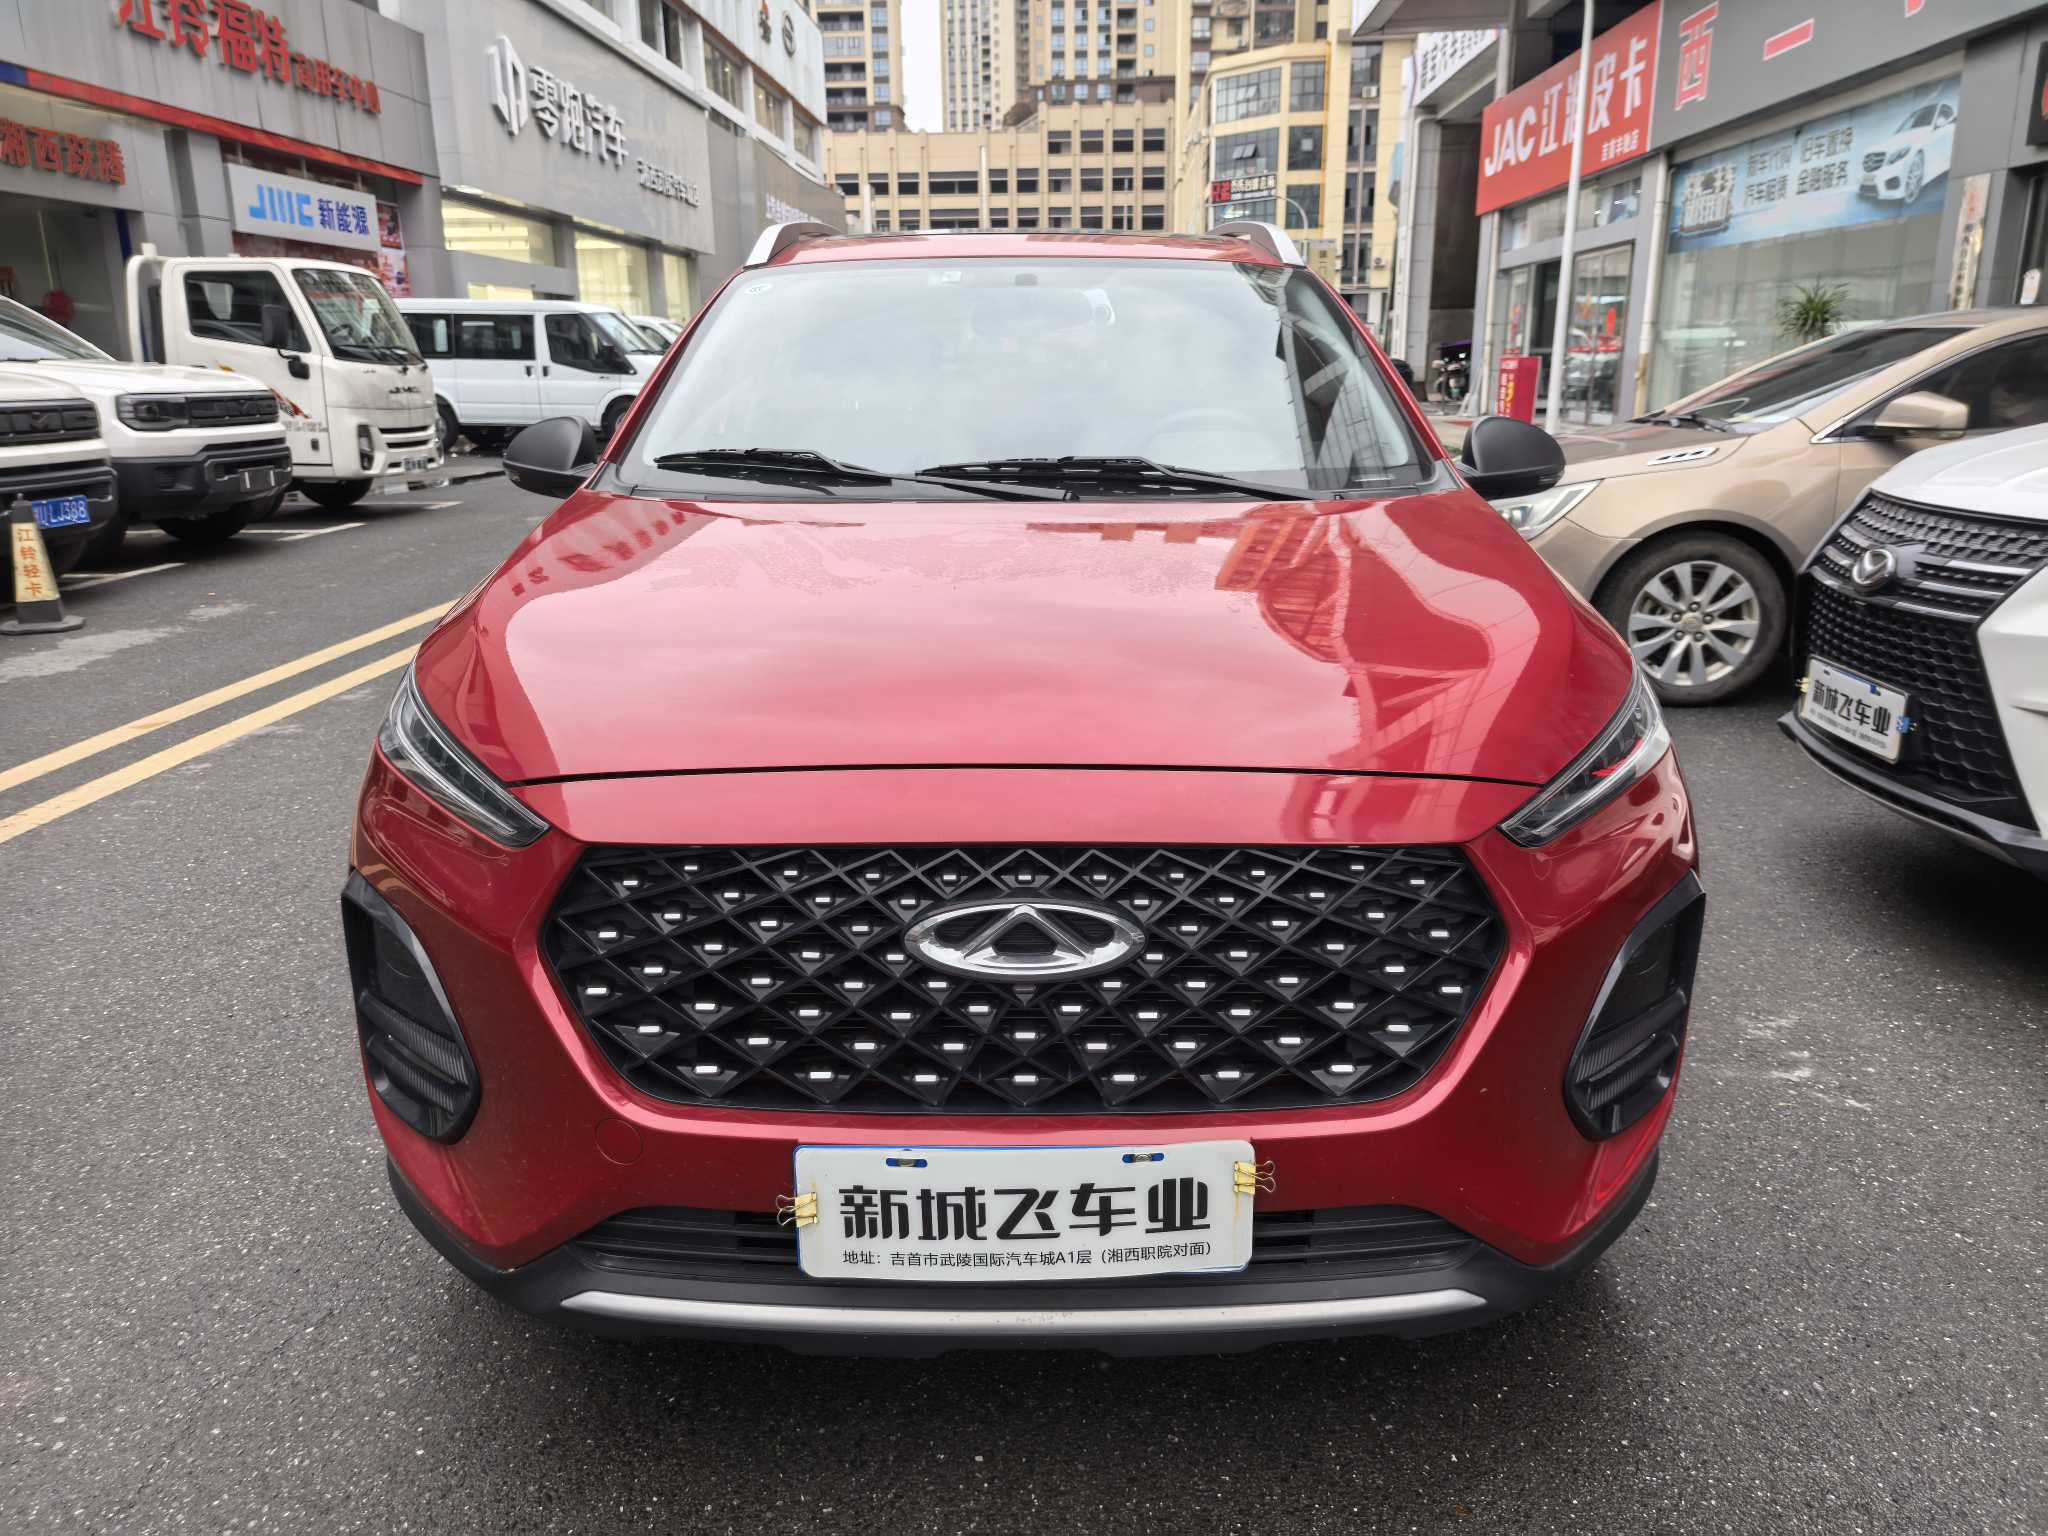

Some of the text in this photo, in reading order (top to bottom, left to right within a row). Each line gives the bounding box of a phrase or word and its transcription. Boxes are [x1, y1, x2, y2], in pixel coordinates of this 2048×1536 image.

[530, 66, 629, 167] 零跑汽车
[1485, 105, 1537, 178] JAC
[317, 198, 370, 236] 新能源
[1812, 680, 1892, 737] 新城飞车业
[838, 1177, 1211, 1241] 新城飞车业
